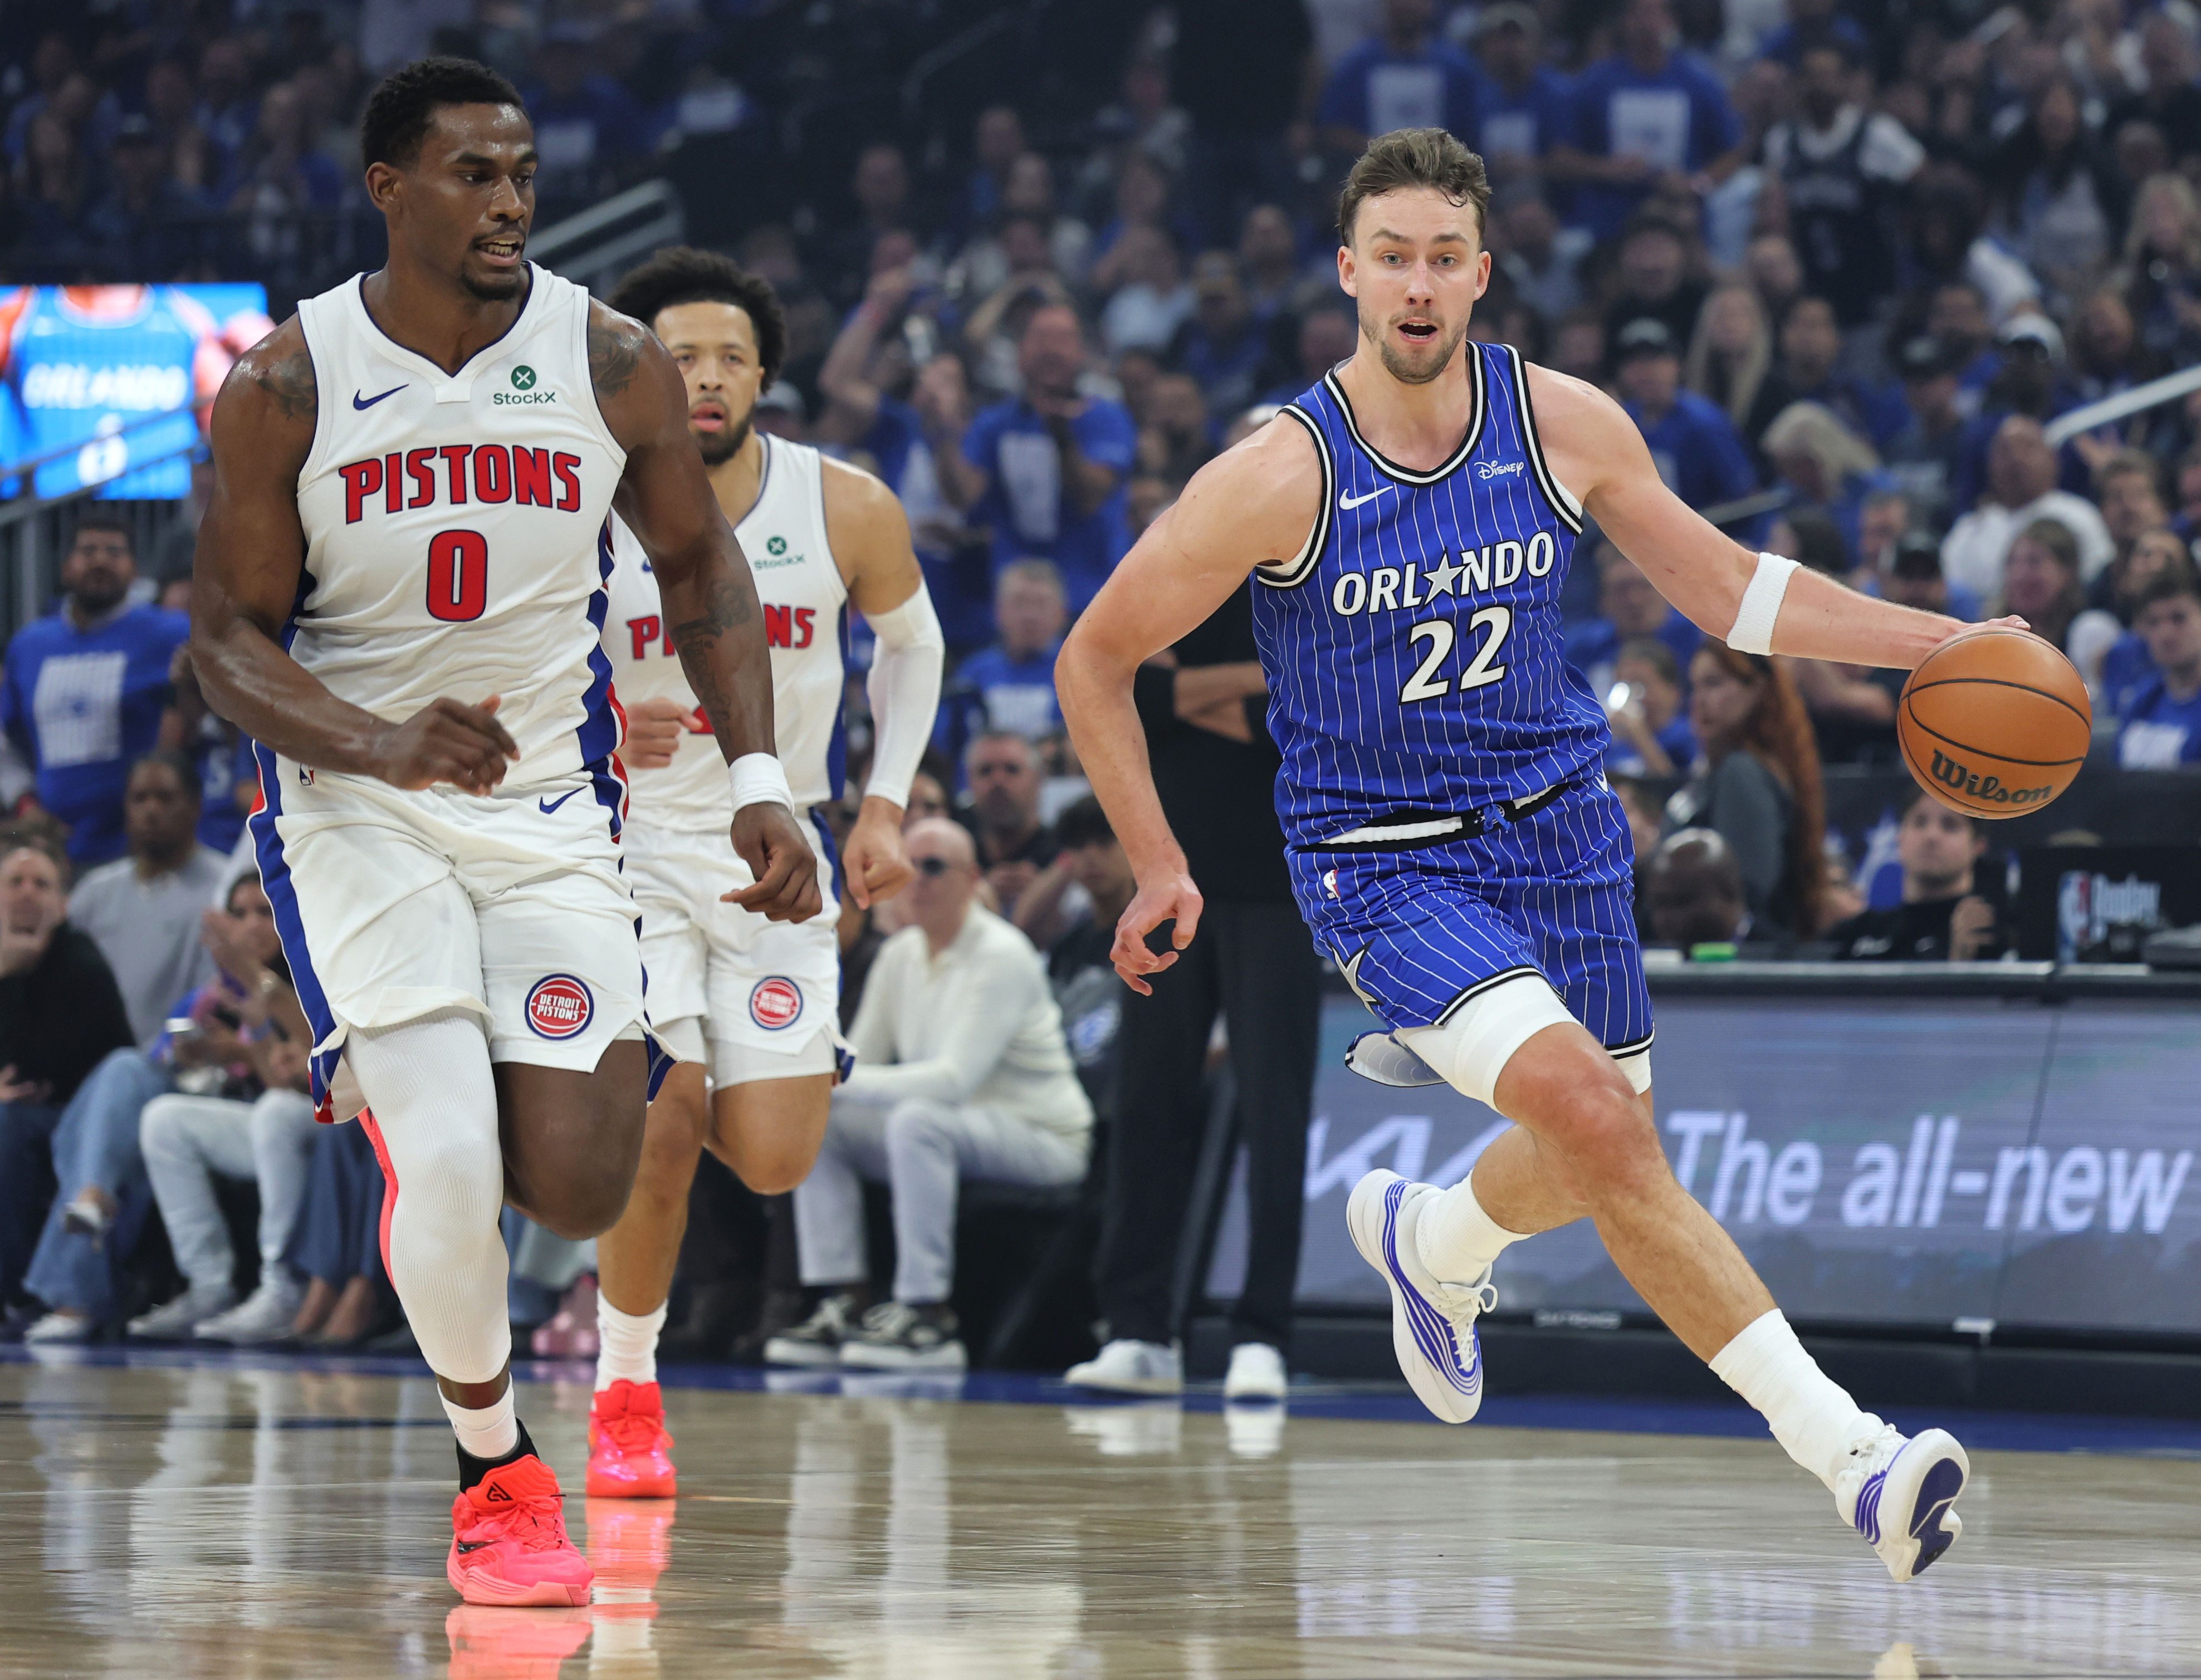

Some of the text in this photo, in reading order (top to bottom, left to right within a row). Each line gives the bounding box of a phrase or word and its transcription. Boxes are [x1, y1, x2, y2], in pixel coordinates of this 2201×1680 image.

[493, 391, 556, 405] StockX
[338, 444, 581, 525] PISTONS
[1474, 460, 1524, 480] Disney
[426, 530, 488, 622] 0
[1398, 606, 1508, 706] 22
[1931, 748, 2052, 803] Wilson
[536, 1004, 579, 1021] PISTONS
[539, 993, 581, 1011] DETROIT
[1665, 1110, 2193, 1235] The all-new
